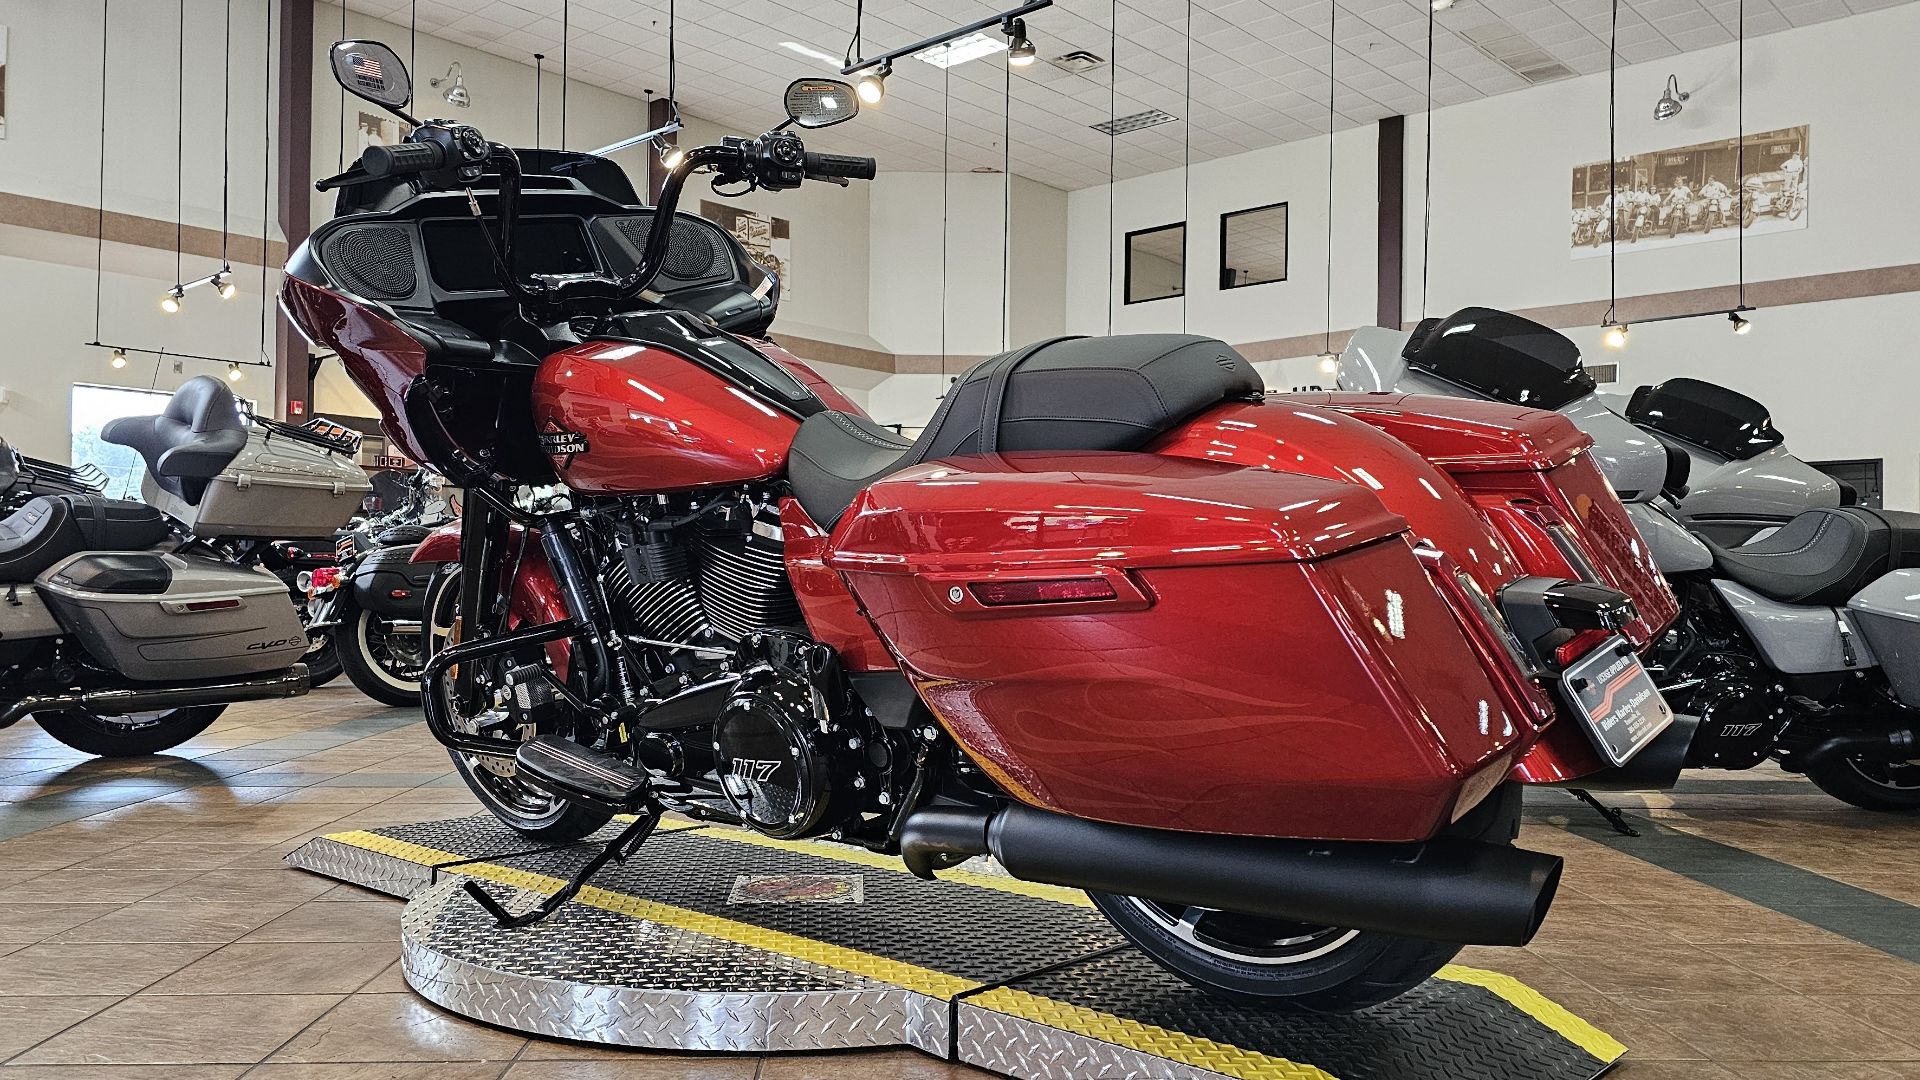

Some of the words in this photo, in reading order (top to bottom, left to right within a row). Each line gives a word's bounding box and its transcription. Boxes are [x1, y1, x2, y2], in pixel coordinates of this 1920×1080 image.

[246, 639, 287, 650] CVO
[1600, 714, 1619, 731] Riders
[1615, 688, 1651, 720] Harley-Davidson
[1720, 722, 1763, 737] 117
[732, 757, 782, 782] 117
